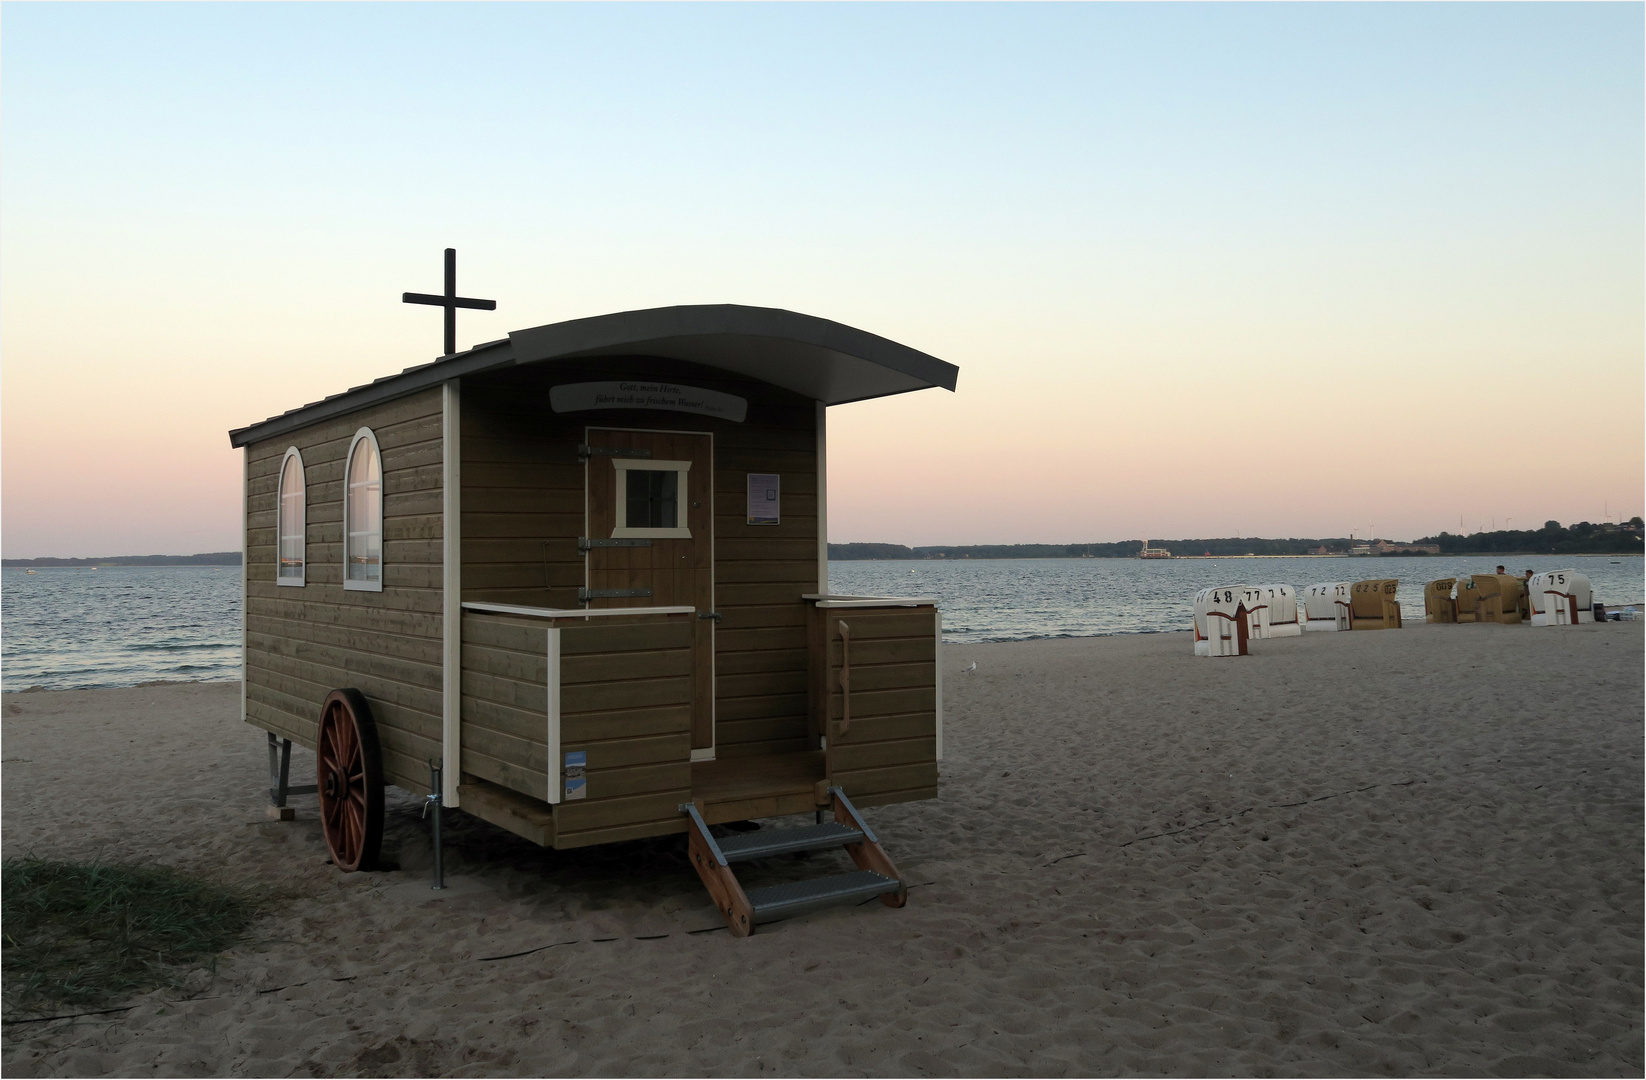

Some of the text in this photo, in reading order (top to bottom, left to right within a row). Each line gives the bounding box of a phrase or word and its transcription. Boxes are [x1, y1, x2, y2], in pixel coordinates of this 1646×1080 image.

[620, 382, 682, 394] Gott, mein Hirte,
[617, 394, 634, 403] mich
[645, 395, 676, 407] frischem
[678, 397, 704, 408] Wasser!
[1436, 581, 1453, 591] 009
[1548, 574, 1565, 586] 75
[1311, 586, 1326, 596] 72
[1355, 583, 1379, 593] 025
[1213, 590, 1233, 604] 48
